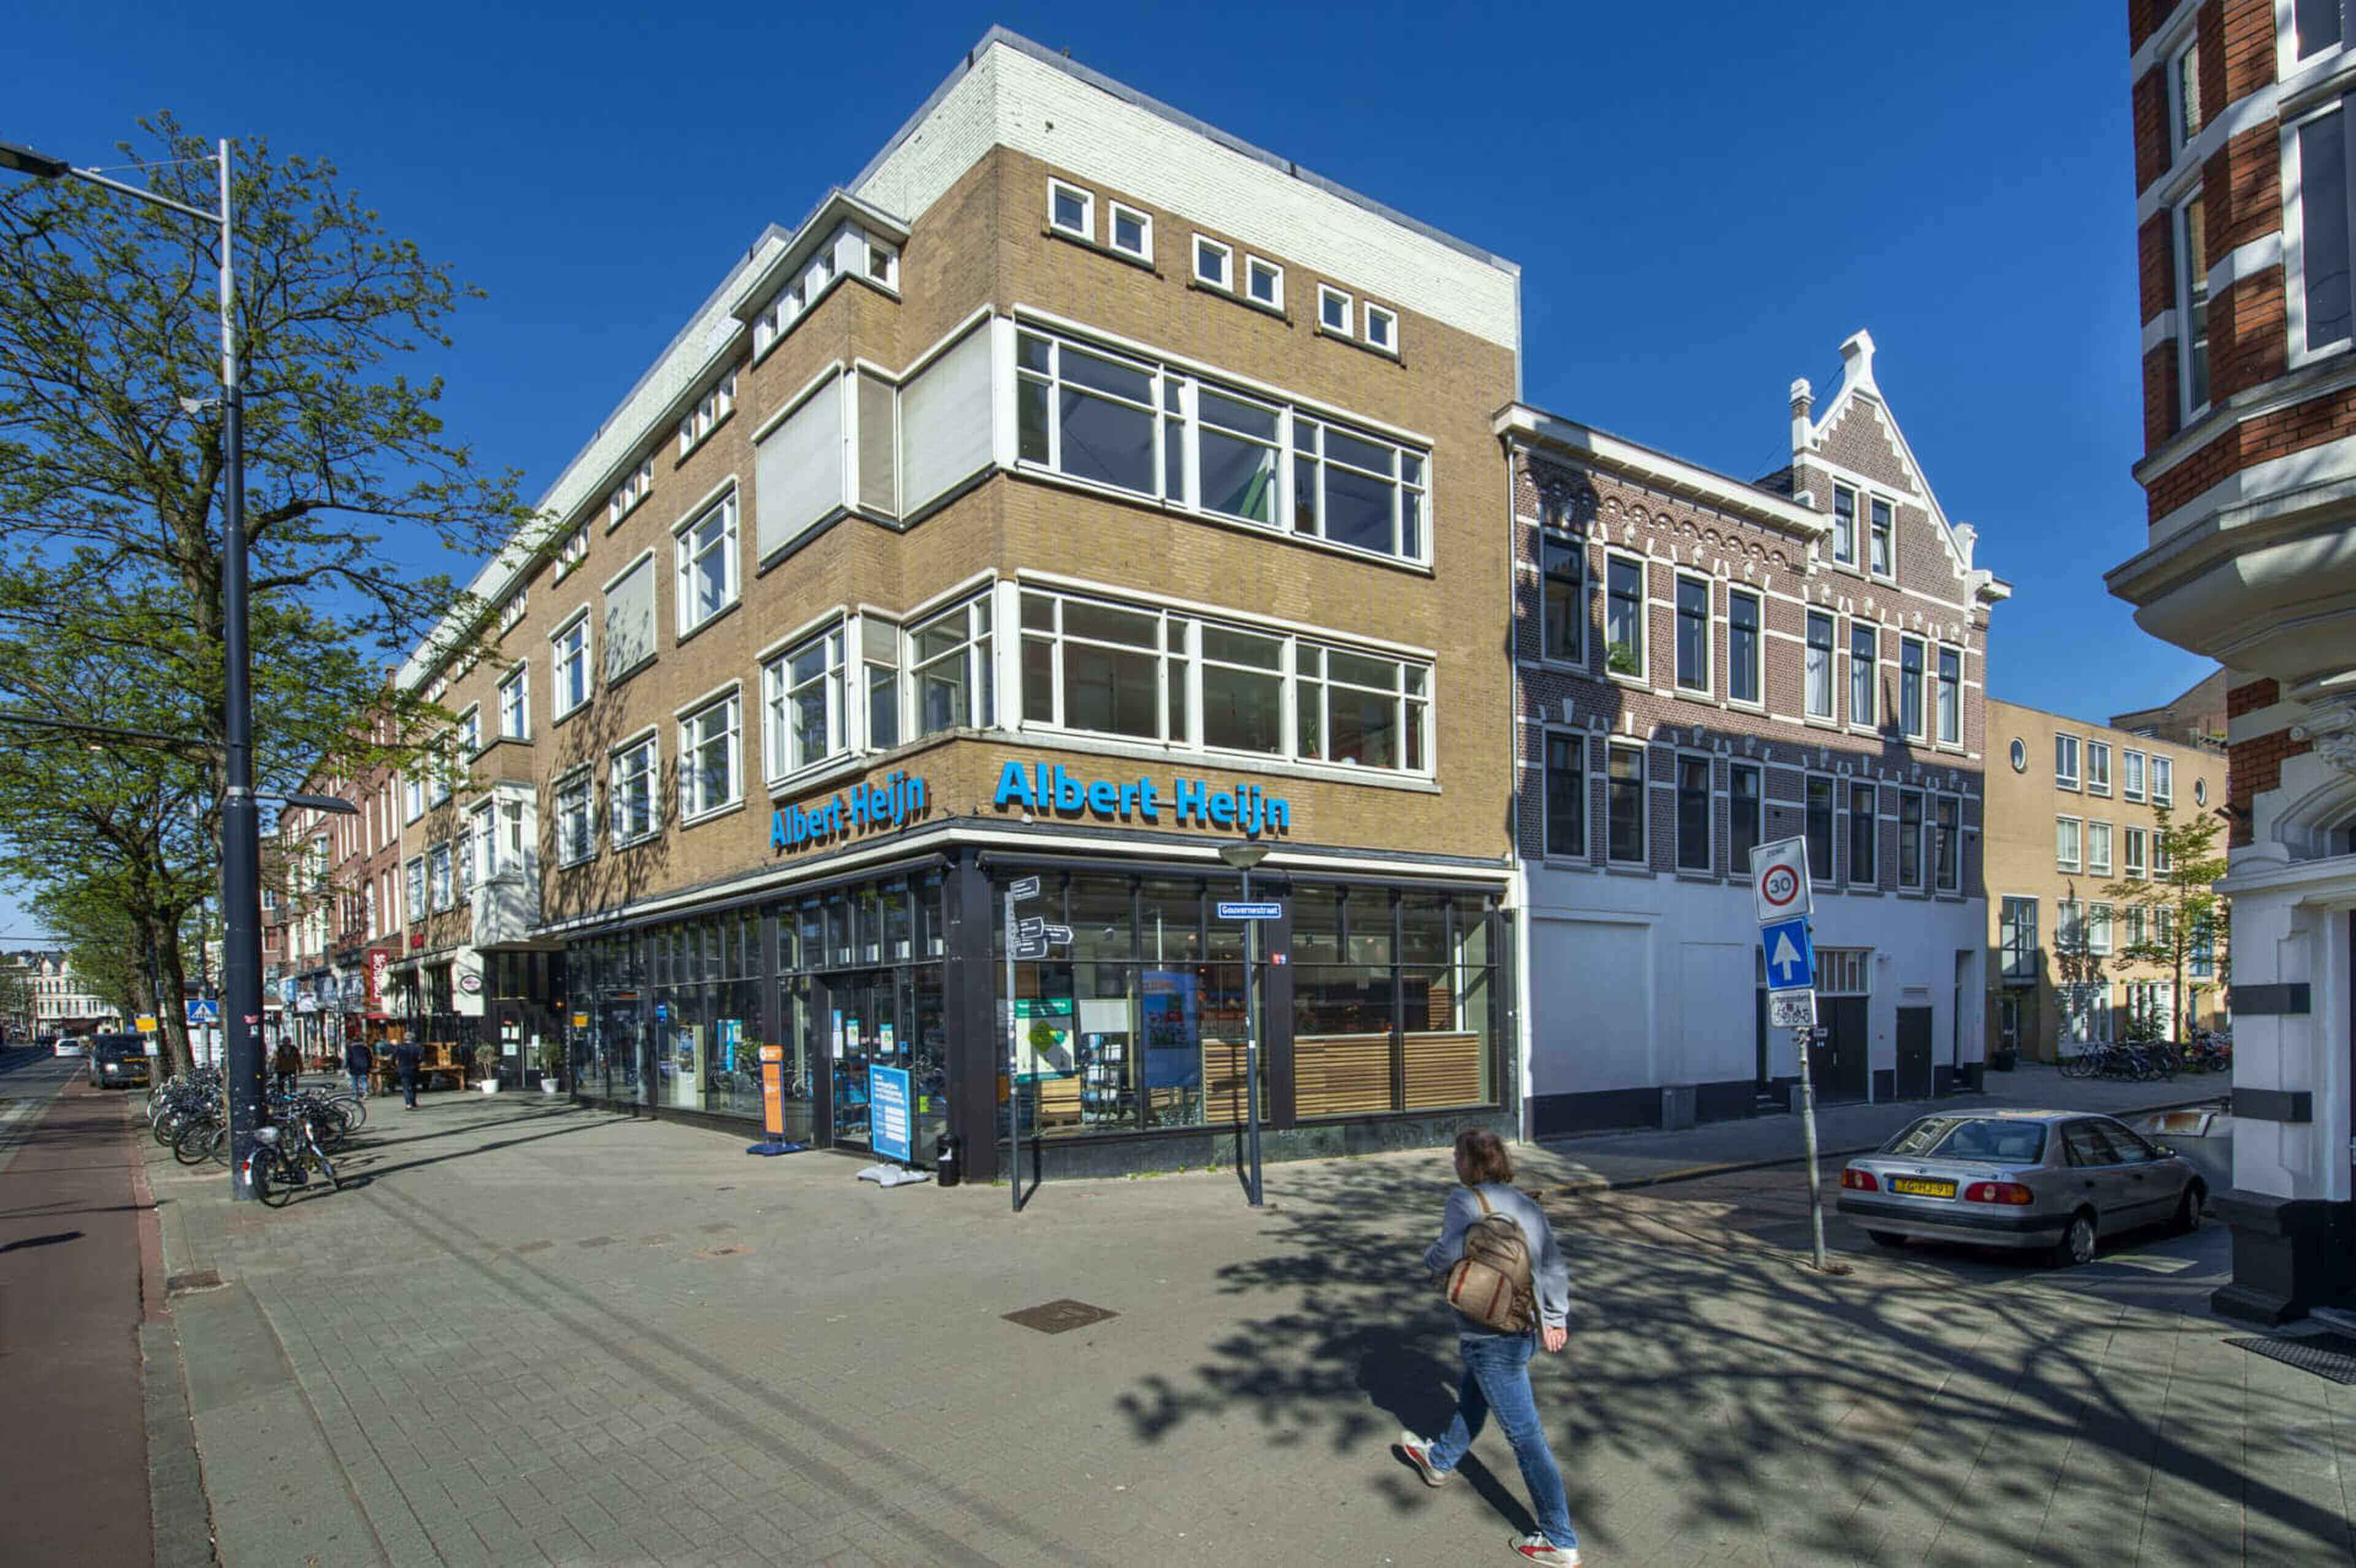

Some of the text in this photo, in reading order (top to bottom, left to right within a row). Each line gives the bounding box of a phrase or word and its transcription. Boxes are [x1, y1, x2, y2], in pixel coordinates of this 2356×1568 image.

[770, 770, 926, 849] Albert Heijn
[993, 761, 1290, 835] Albert Heijn
[1769, 877, 1792, 894] 30
